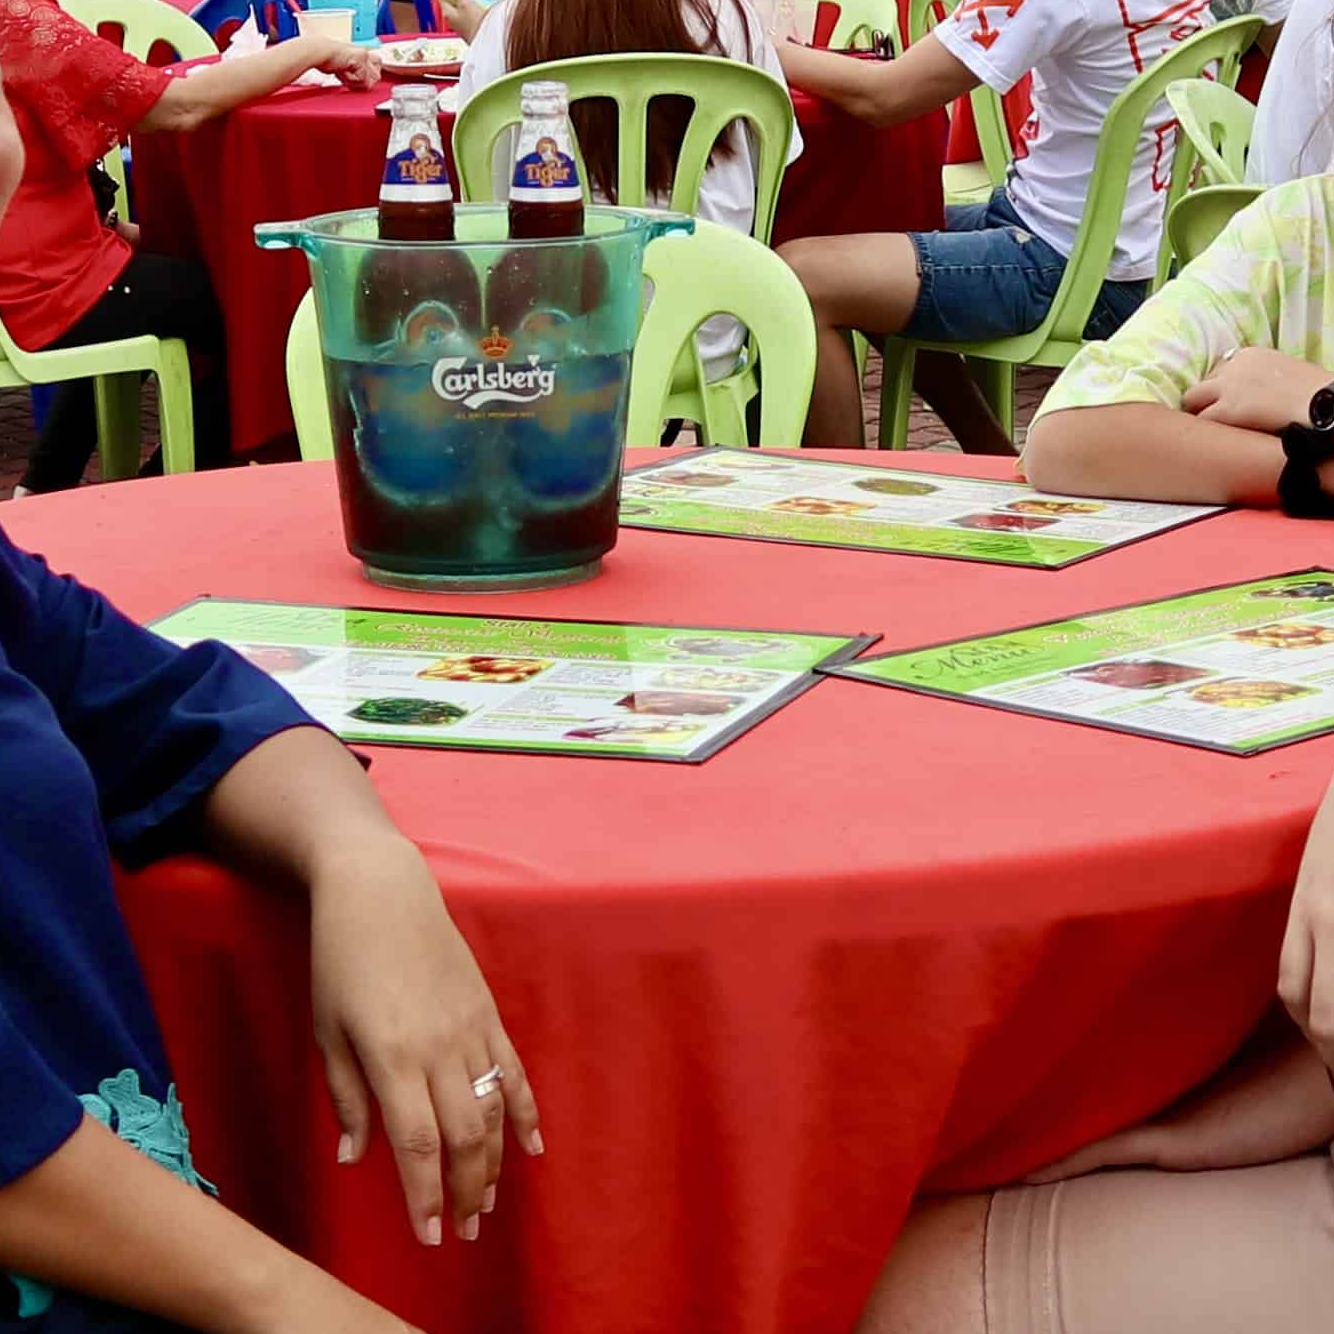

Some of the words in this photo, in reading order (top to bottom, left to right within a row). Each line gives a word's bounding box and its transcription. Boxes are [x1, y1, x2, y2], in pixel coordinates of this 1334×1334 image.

[398, 156, 444, 184] Tiger
[525, 158, 571, 187] Tiger
[431, 355, 556, 405] Carlsberg
